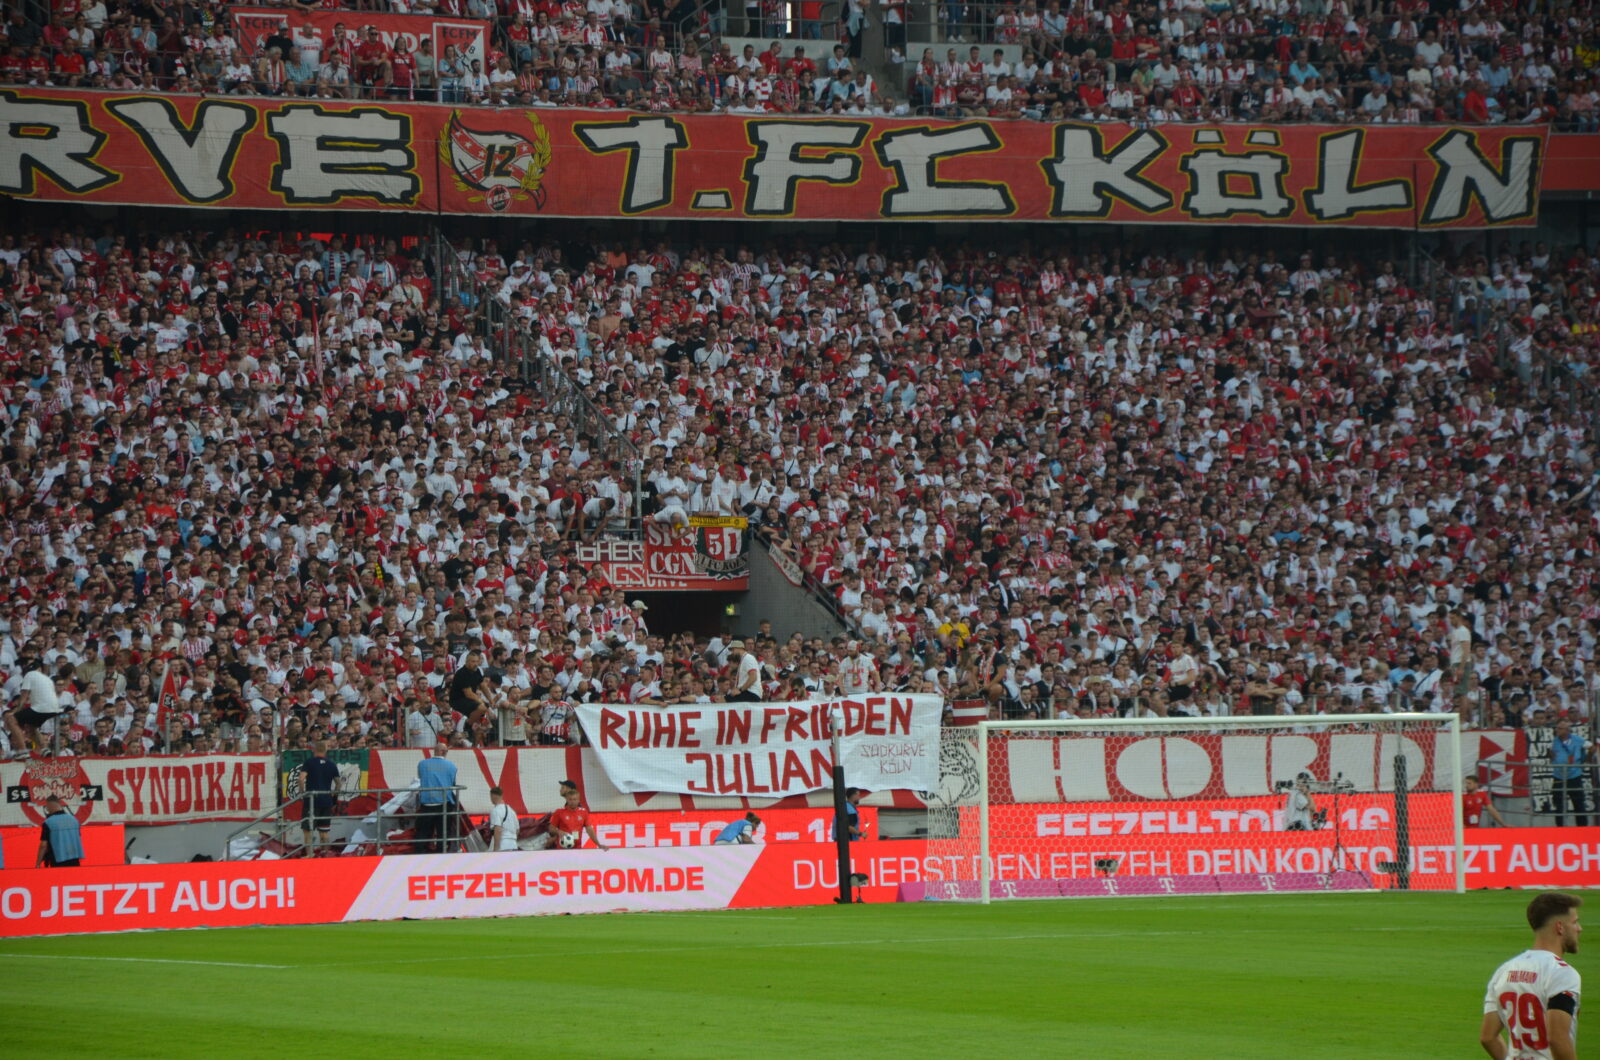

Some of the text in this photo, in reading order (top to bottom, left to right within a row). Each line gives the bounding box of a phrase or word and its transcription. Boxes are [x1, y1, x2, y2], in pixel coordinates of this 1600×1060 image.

[483, 143, 517, 178] 12
[1036, 121, 1542, 226] KÖLN
[599, 697, 914, 750] RUHE IN FRIEDEN
[107, 761, 266, 815] SYNDIKAT
[685, 744, 834, 795] JULIAN
[407, 866, 705, 901] EFFZEH-STROM.DE
[793, 859, 839, 890] DU
[1187, 848, 1268, 876] DEIN
[1275, 846, 1395, 874] KONTO
[40, 881, 165, 918] JETZT
[170, 876, 296, 913] AUCH!
[1498, 991, 1549, 1051] 29
